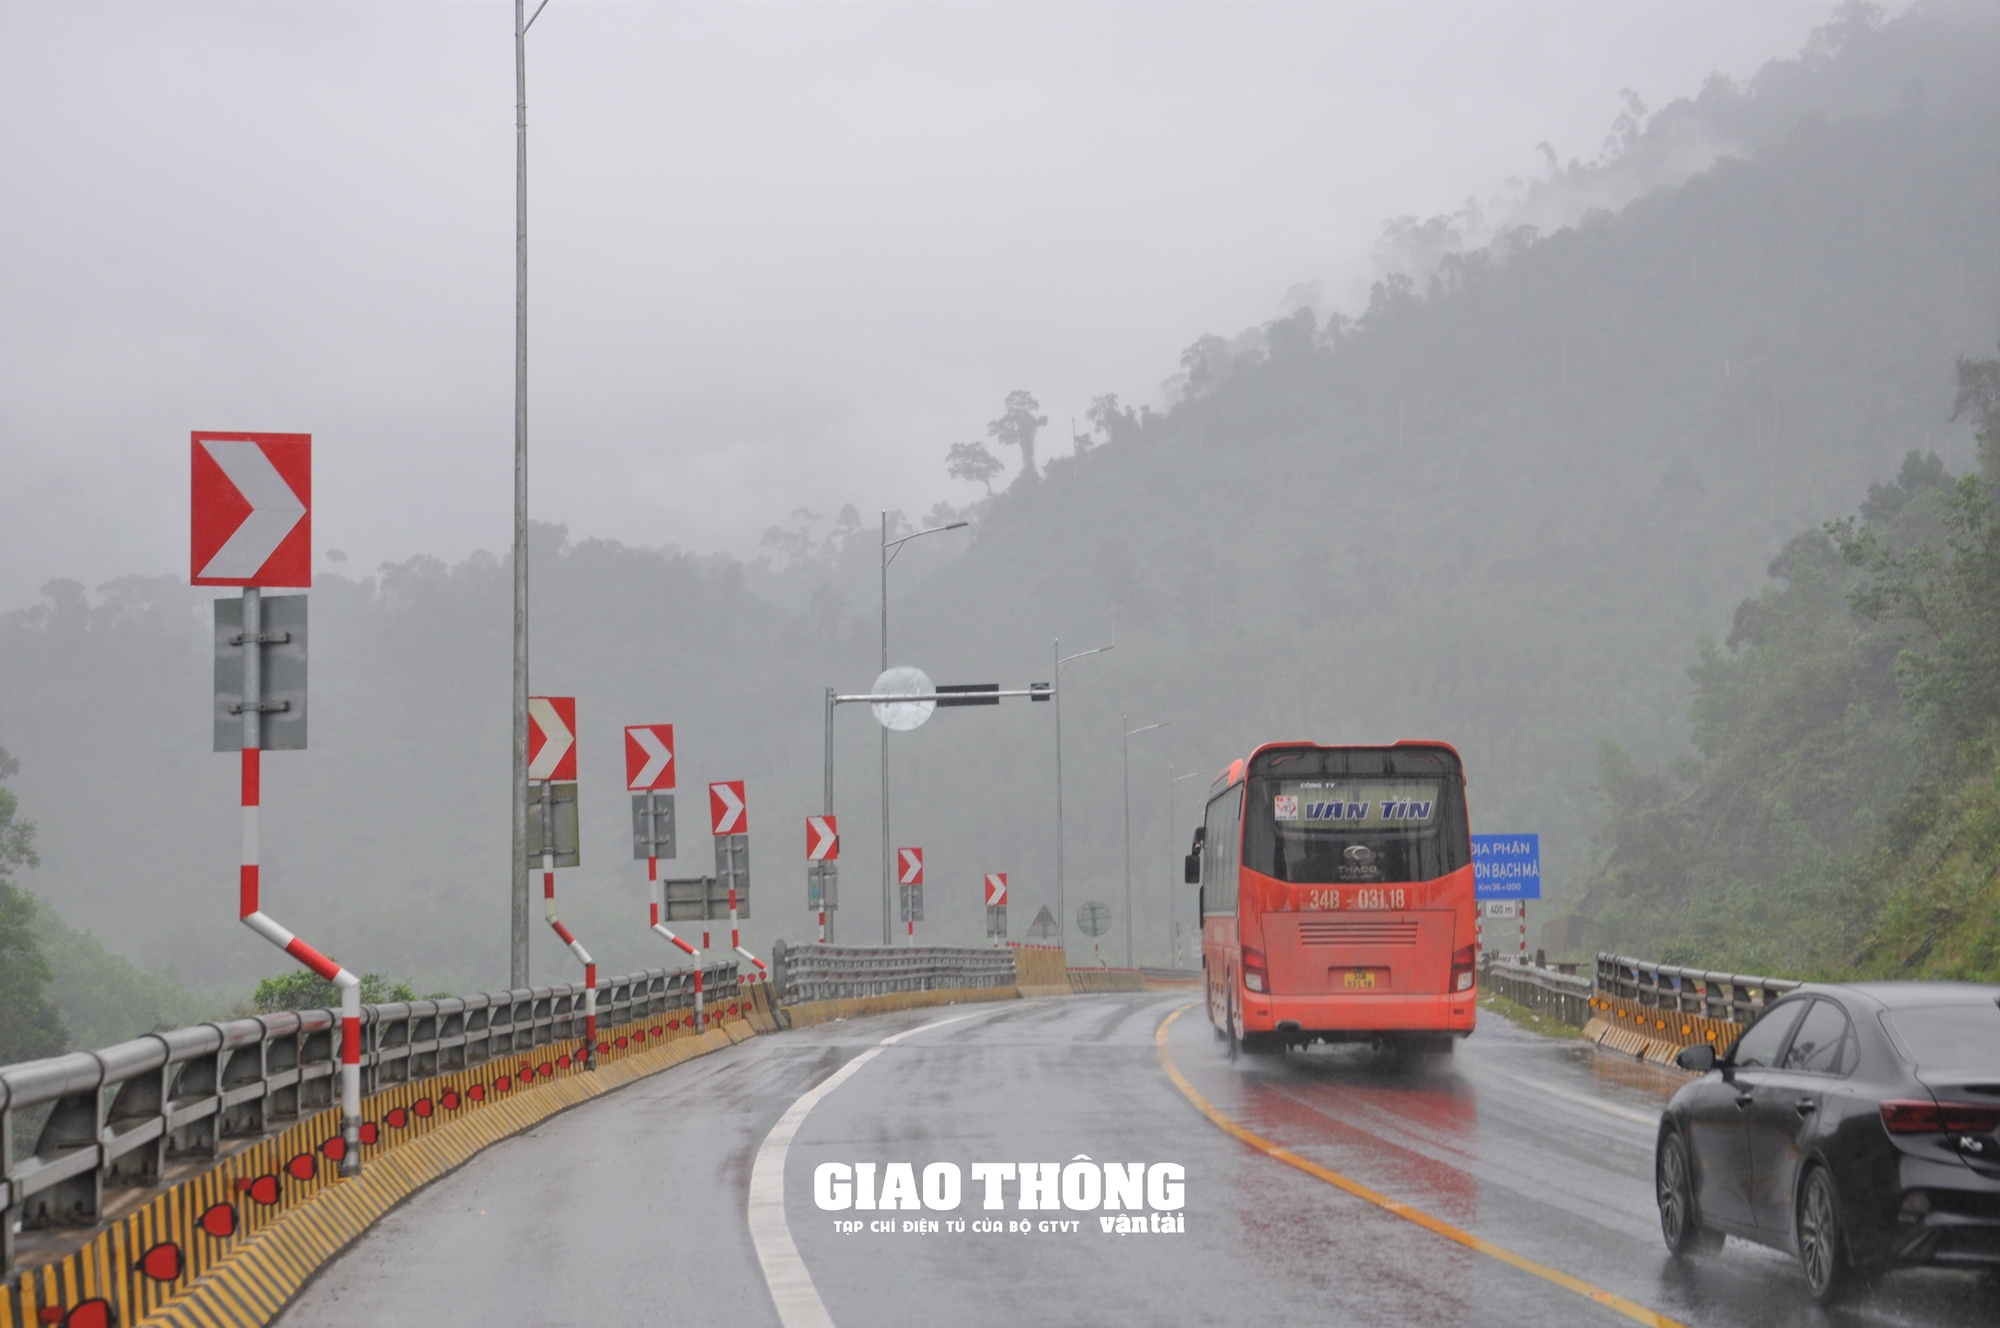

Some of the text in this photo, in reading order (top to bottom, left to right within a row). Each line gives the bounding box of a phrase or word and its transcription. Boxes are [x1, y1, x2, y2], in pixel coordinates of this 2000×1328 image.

[1380, 797, 1432, 820] TÍN
[1493, 840, 1530, 857] PHẬN
[1473, 859, 1539, 880] ỜN BẠCH MÃ
[1310, 889, 1340, 909] 34B
[1358, 888, 1405, 909] 031.18
[1505, 906, 1513, 914] m
